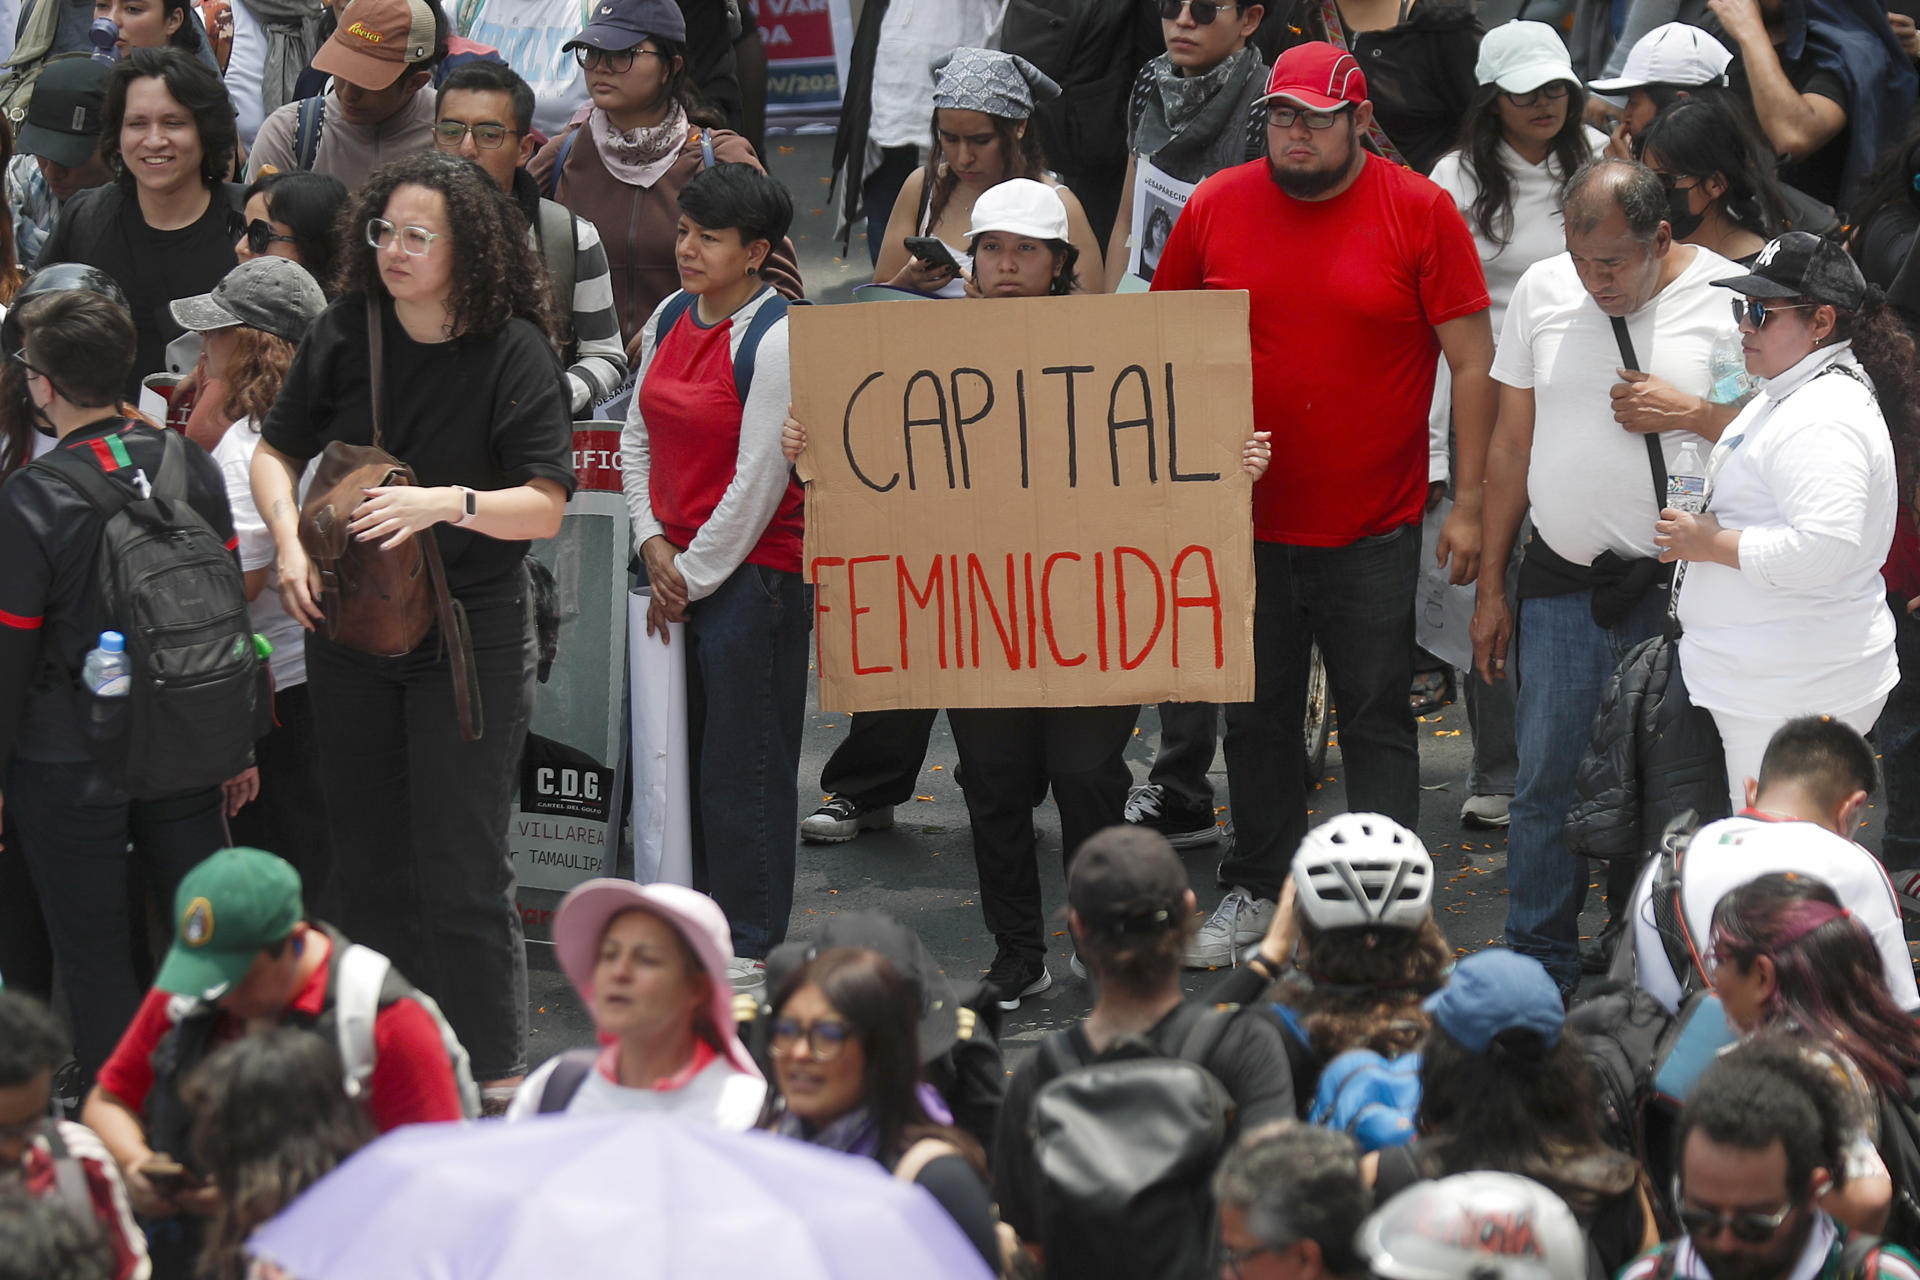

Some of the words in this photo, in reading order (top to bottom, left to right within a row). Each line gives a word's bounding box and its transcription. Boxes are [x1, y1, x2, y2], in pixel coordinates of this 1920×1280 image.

[1144, 177, 1190, 203] DESAPARECID
[843, 362, 1221, 492] CAPITAL
[811, 544, 1224, 679] FEMINICIDA
[537, 767, 602, 801] C.D.G.
[537, 801, 565, 809] CARTEL
